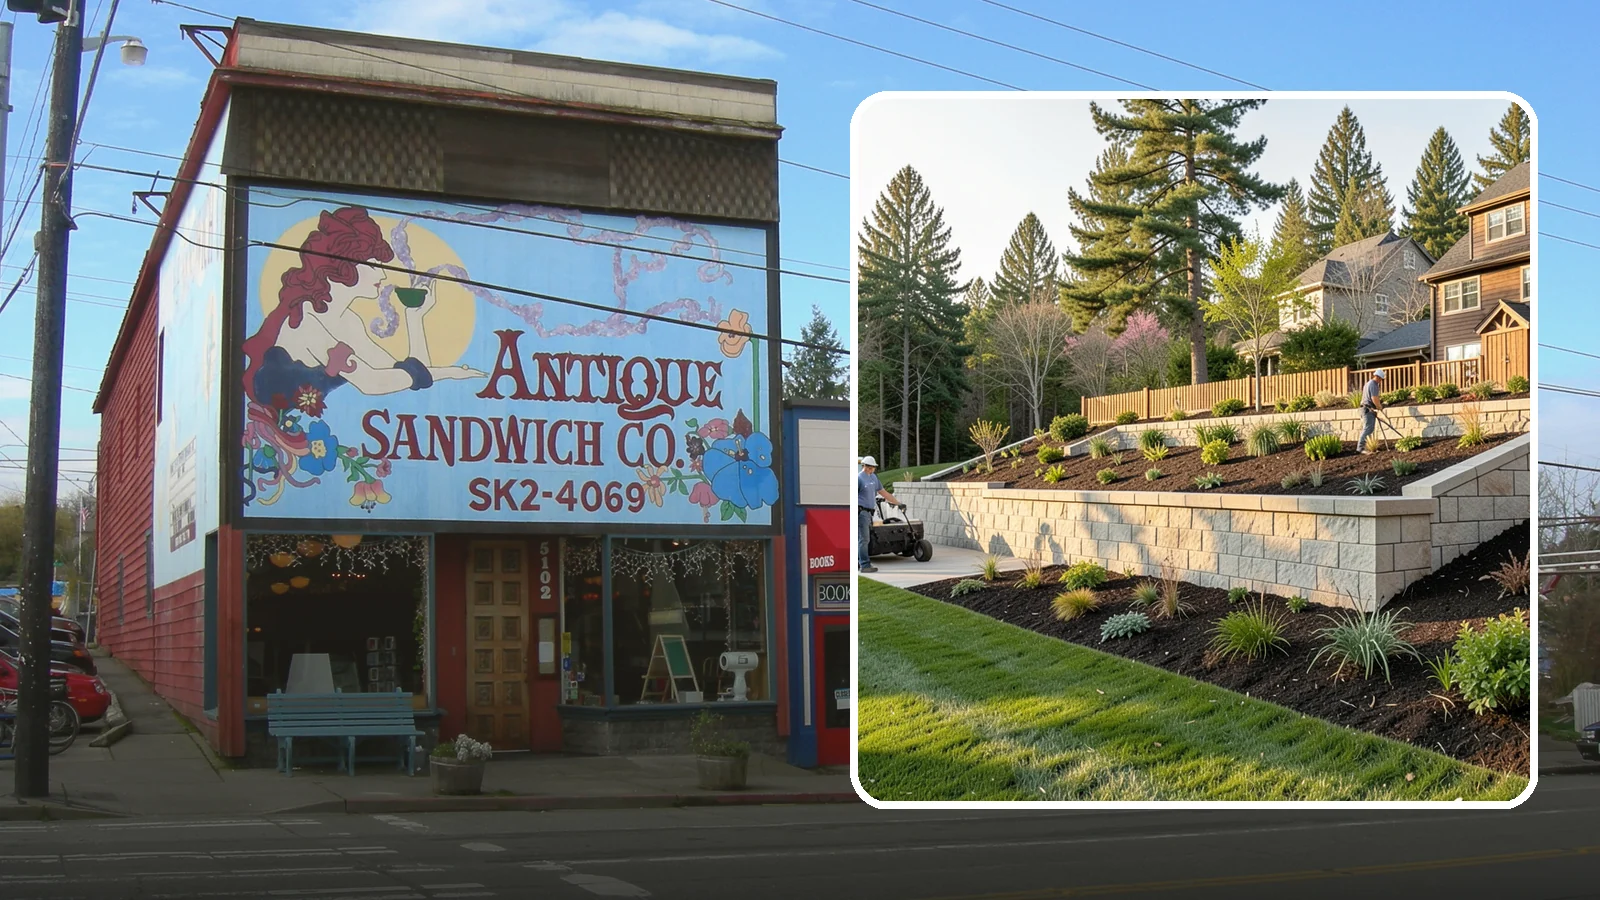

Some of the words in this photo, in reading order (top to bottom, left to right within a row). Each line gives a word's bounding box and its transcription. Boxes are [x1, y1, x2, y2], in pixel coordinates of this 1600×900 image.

[476, 329, 723, 421] ANTIQUE
[361, 408, 604, 467] SANDWICH
[617, 421, 684, 469] CO.
[468, 477, 645, 513] SK2-4069
[539, 541, 551, 600] 5102
[809, 555, 835, 569] BOOKS
